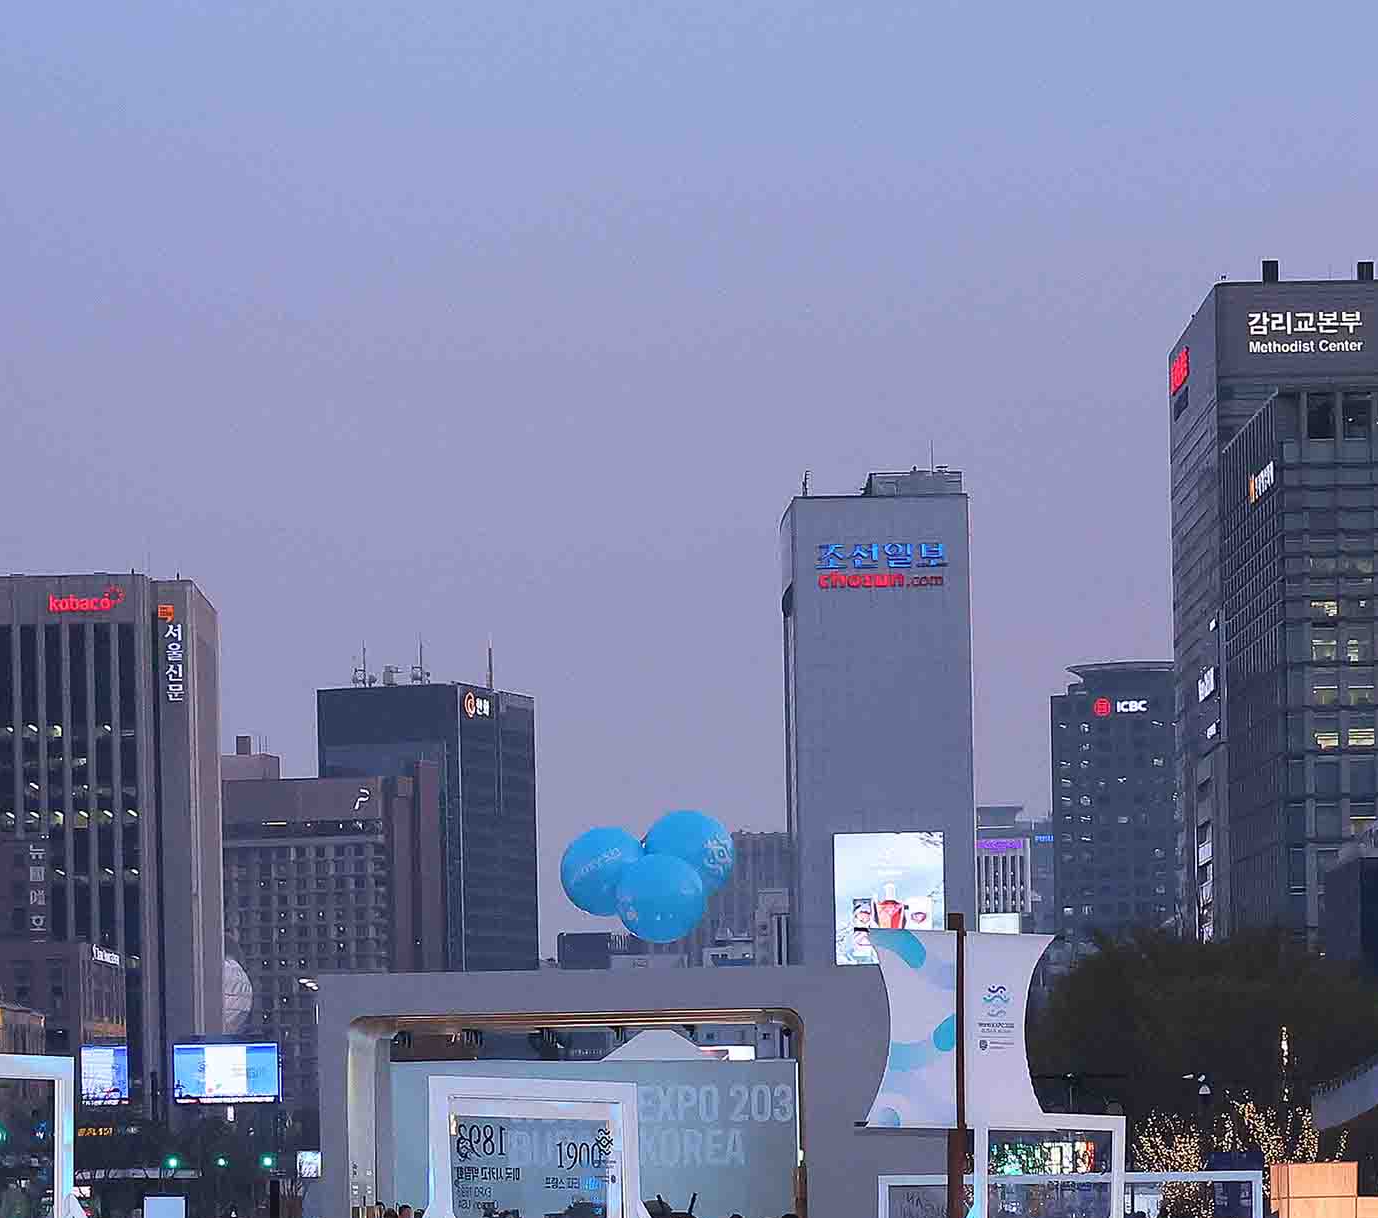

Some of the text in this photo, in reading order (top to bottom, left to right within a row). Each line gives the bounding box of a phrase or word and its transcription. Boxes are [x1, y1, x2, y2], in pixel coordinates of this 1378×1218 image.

[1246, 311, 1363, 336] 감리교본부
[1248, 339, 1364, 354] Methodist Center
[815, 542, 949, 570] 조선일보
[818, 571, 944, 589] chosun.com
[47, 592, 112, 613] kobaco
[163, 623, 185, 702] 서울신문
[1116, 700, 1148, 713] ICBC
[640, 1084, 795, 1121] EXPO 203
[556, 1142, 602, 1170] 1900
